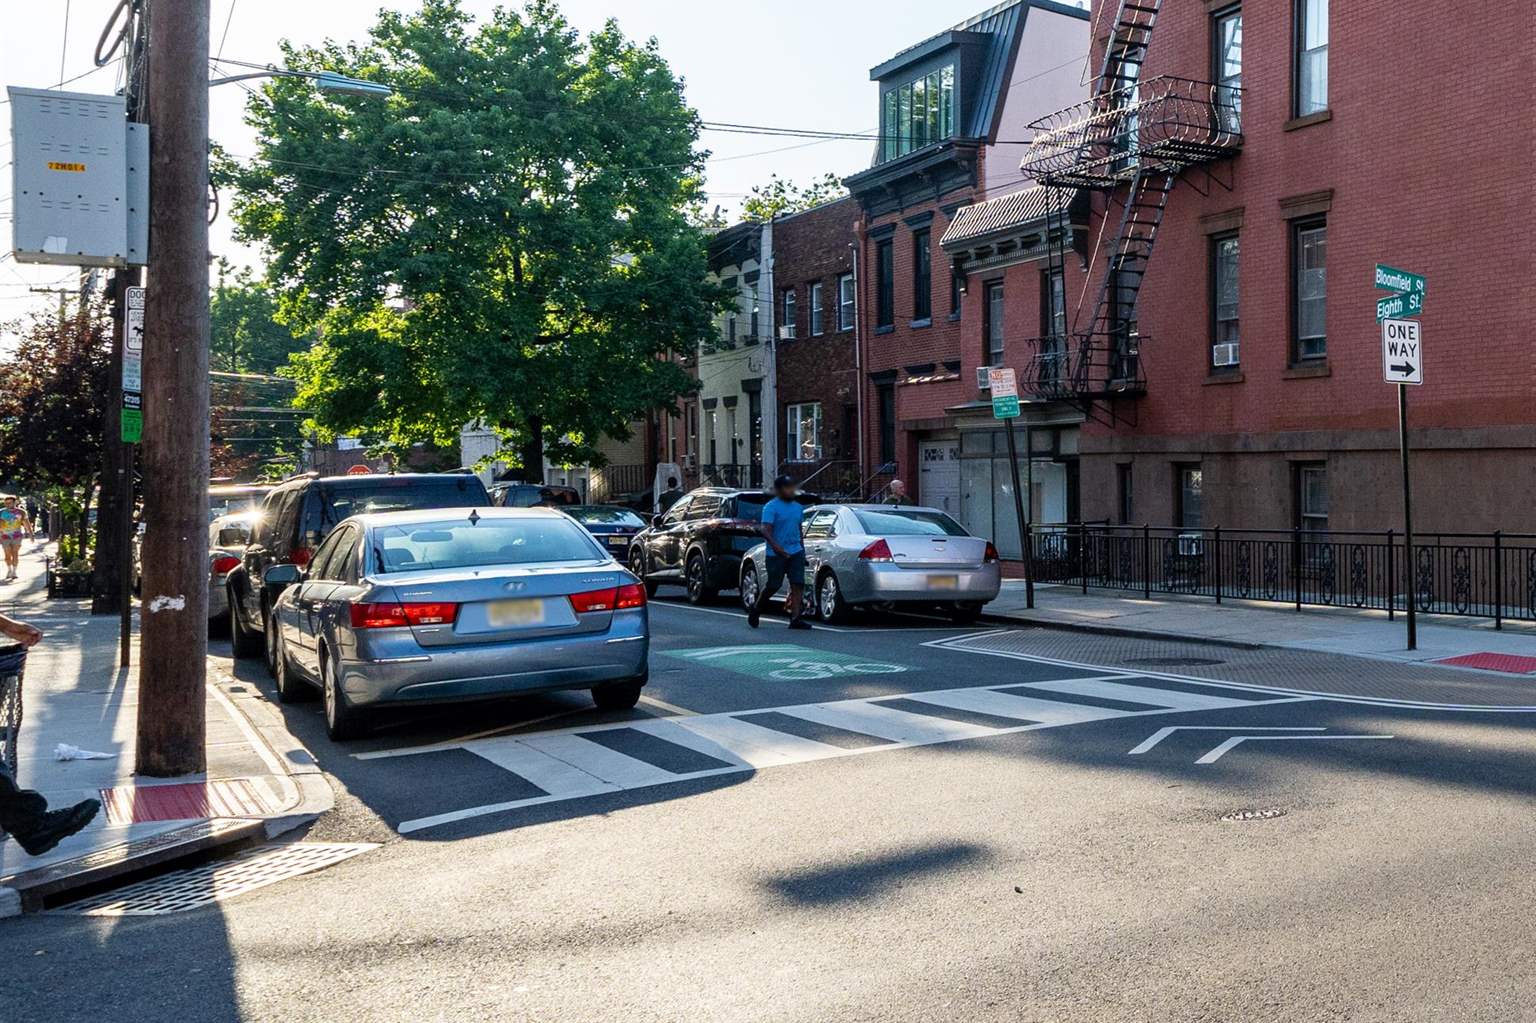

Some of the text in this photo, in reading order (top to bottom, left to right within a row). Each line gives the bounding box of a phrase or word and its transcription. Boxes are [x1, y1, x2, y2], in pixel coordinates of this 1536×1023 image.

[1376, 268, 1411, 292] Bloomfield
[1377, 298, 1403, 318] Eighth
[1388, 324, 1416, 340] ONE
[1387, 342, 1417, 357] WAY
